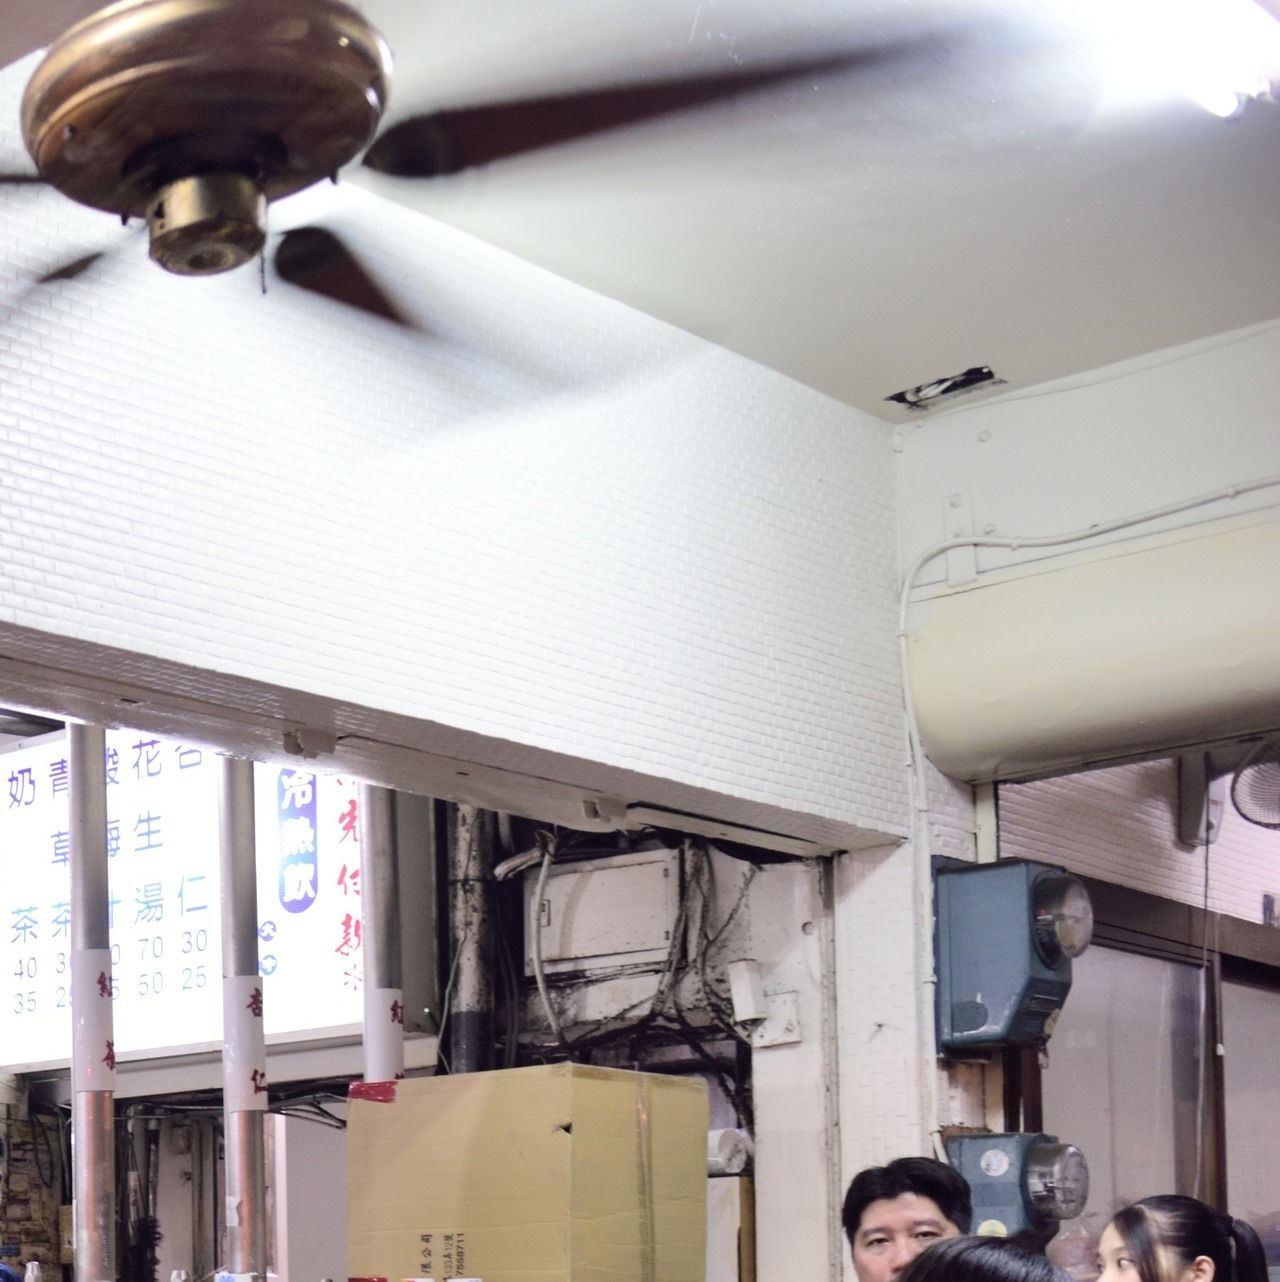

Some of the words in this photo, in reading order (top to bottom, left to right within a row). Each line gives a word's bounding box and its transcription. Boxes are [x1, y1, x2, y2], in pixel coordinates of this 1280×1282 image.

[7, 767, 39, 944] 奶茶
[131, 739, 164, 925] 花生湯
[281, 769, 316, 903] 冷熱飲
[14, 956, 38, 980] 40
[138, 936, 163, 960] 70
[182, 929, 208, 954] 30
[14, 991, 37, 1015] 35
[138, 972, 163, 997] 50
[182, 965, 208, 990] 25
[246, 986, 268, 1095] 杏仁
